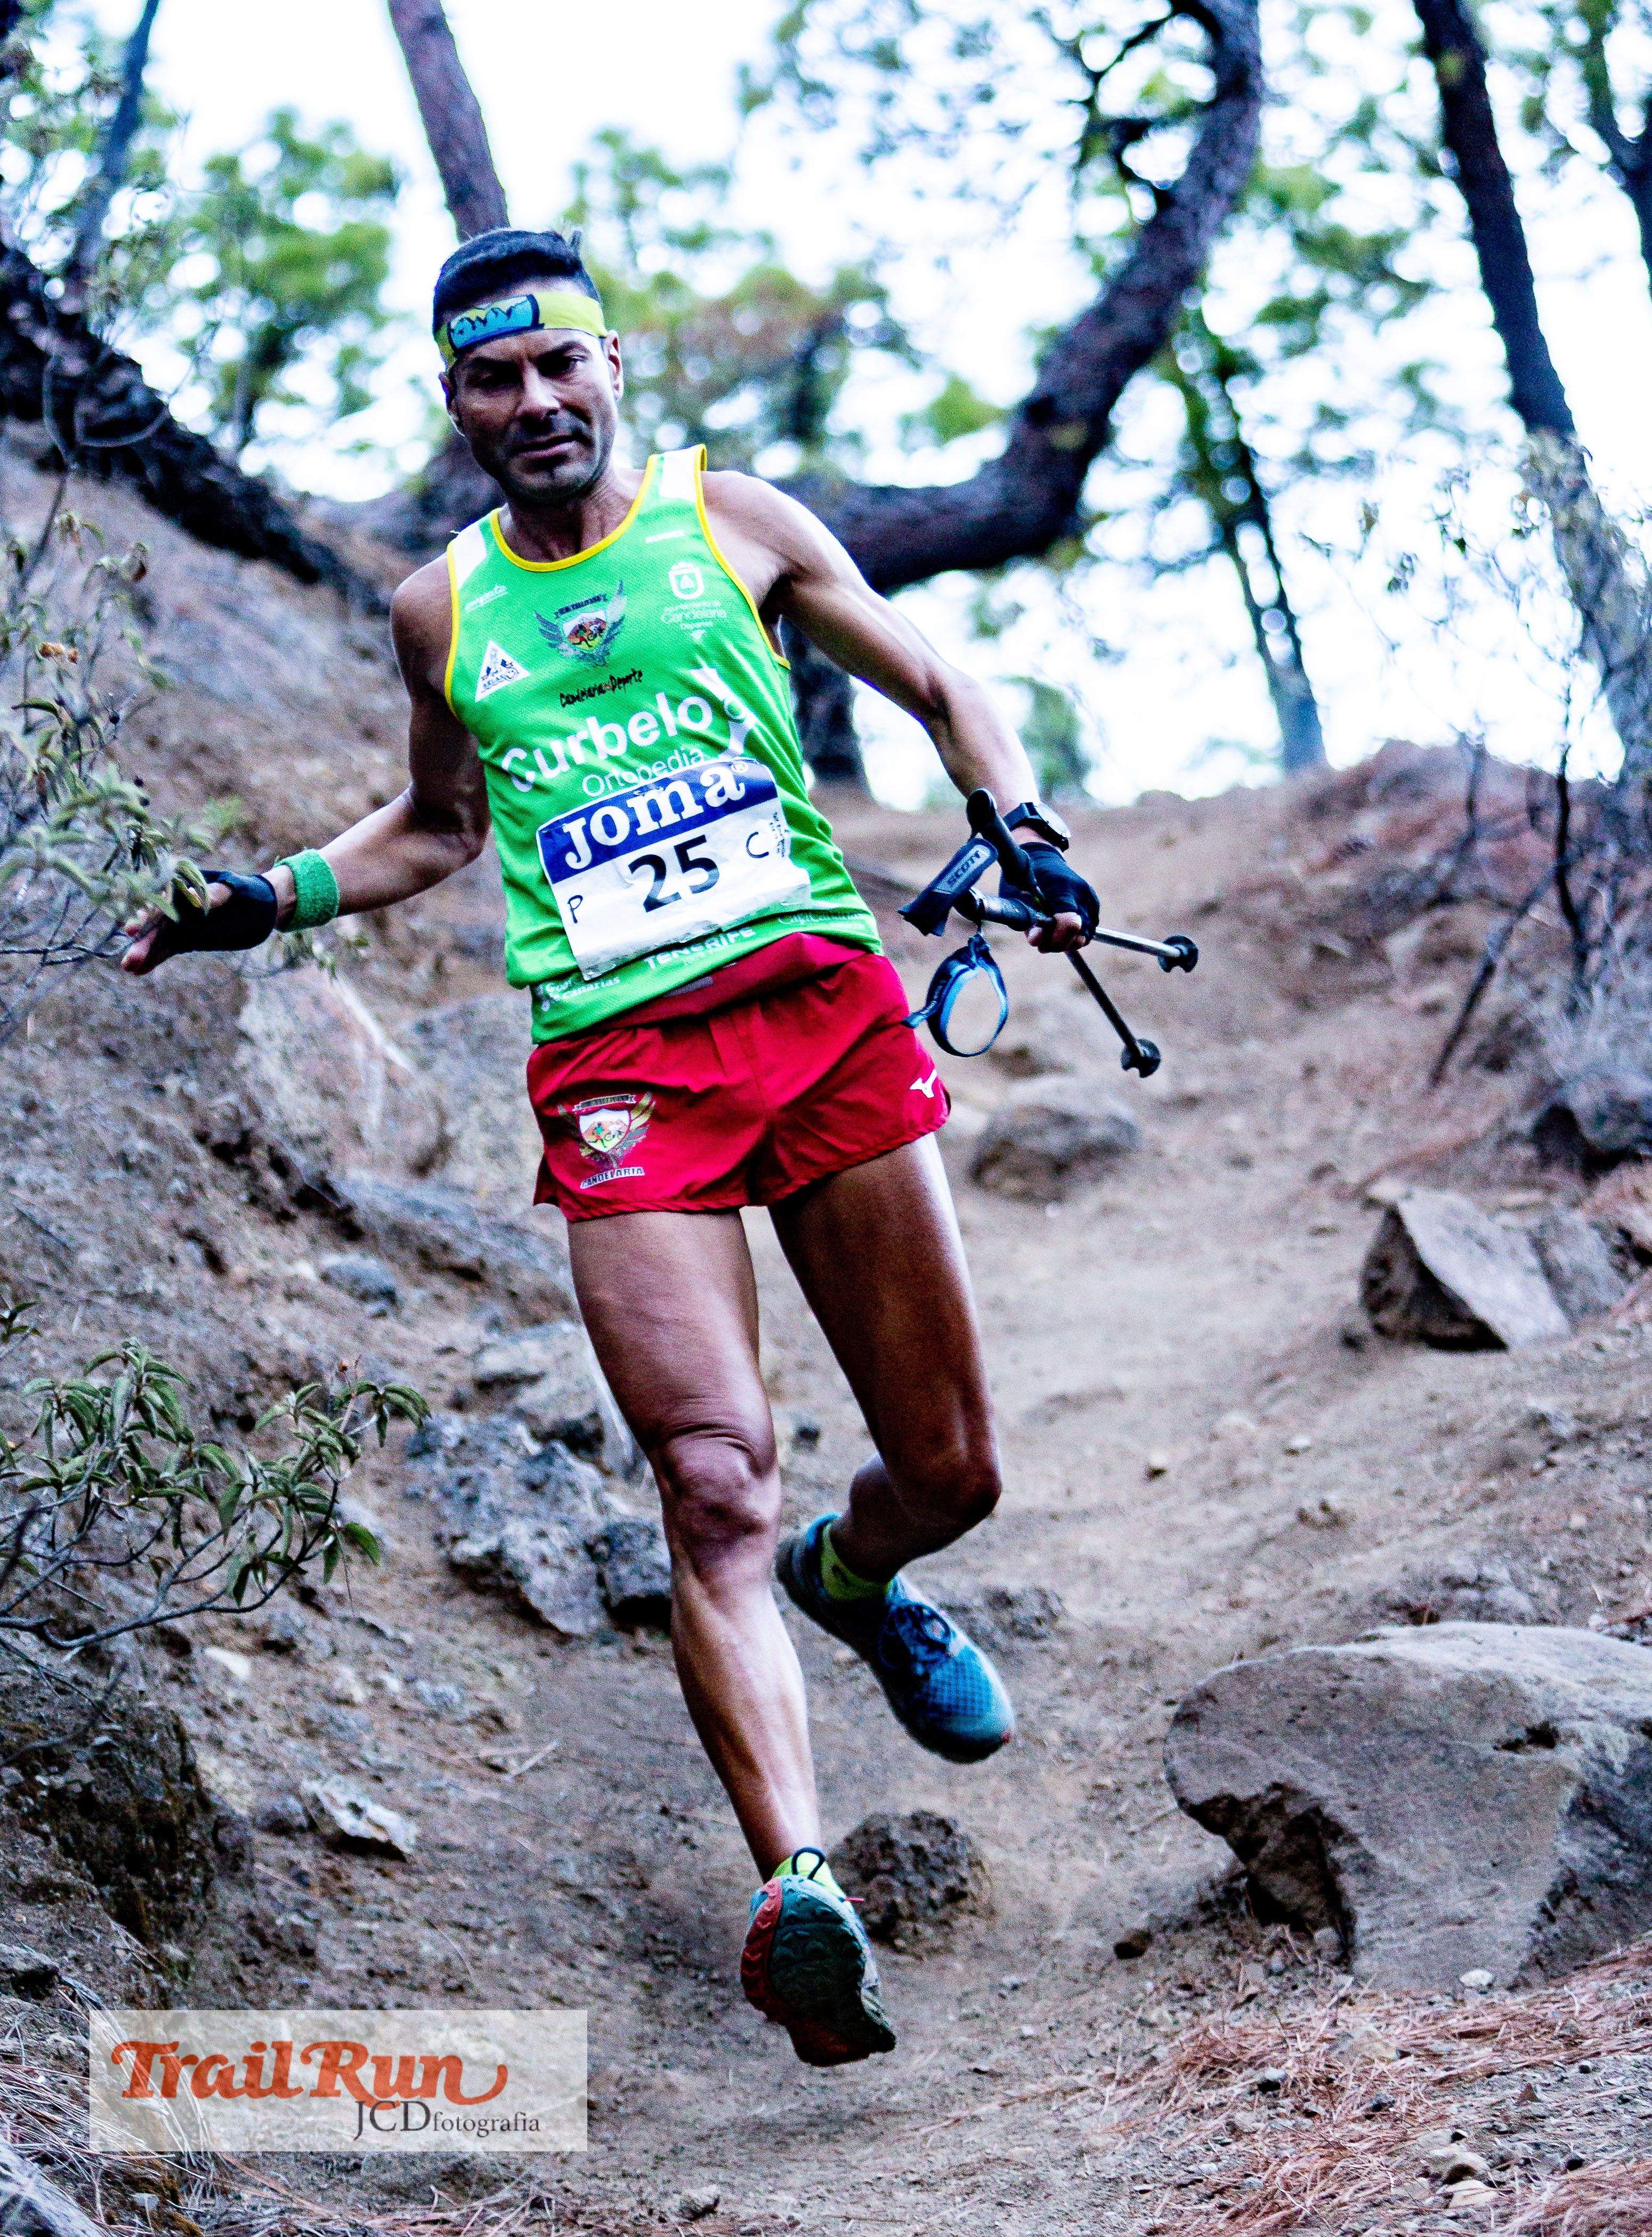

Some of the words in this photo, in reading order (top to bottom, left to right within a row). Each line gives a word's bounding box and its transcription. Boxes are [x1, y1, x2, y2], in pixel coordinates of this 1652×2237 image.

[501, 692, 713, 792] Curbelo
[582, 747, 704, 797] Ortopedia
[567, 895, 583, 923] P
[628, 834, 720, 912] 25
[746, 831, 769, 859] C
